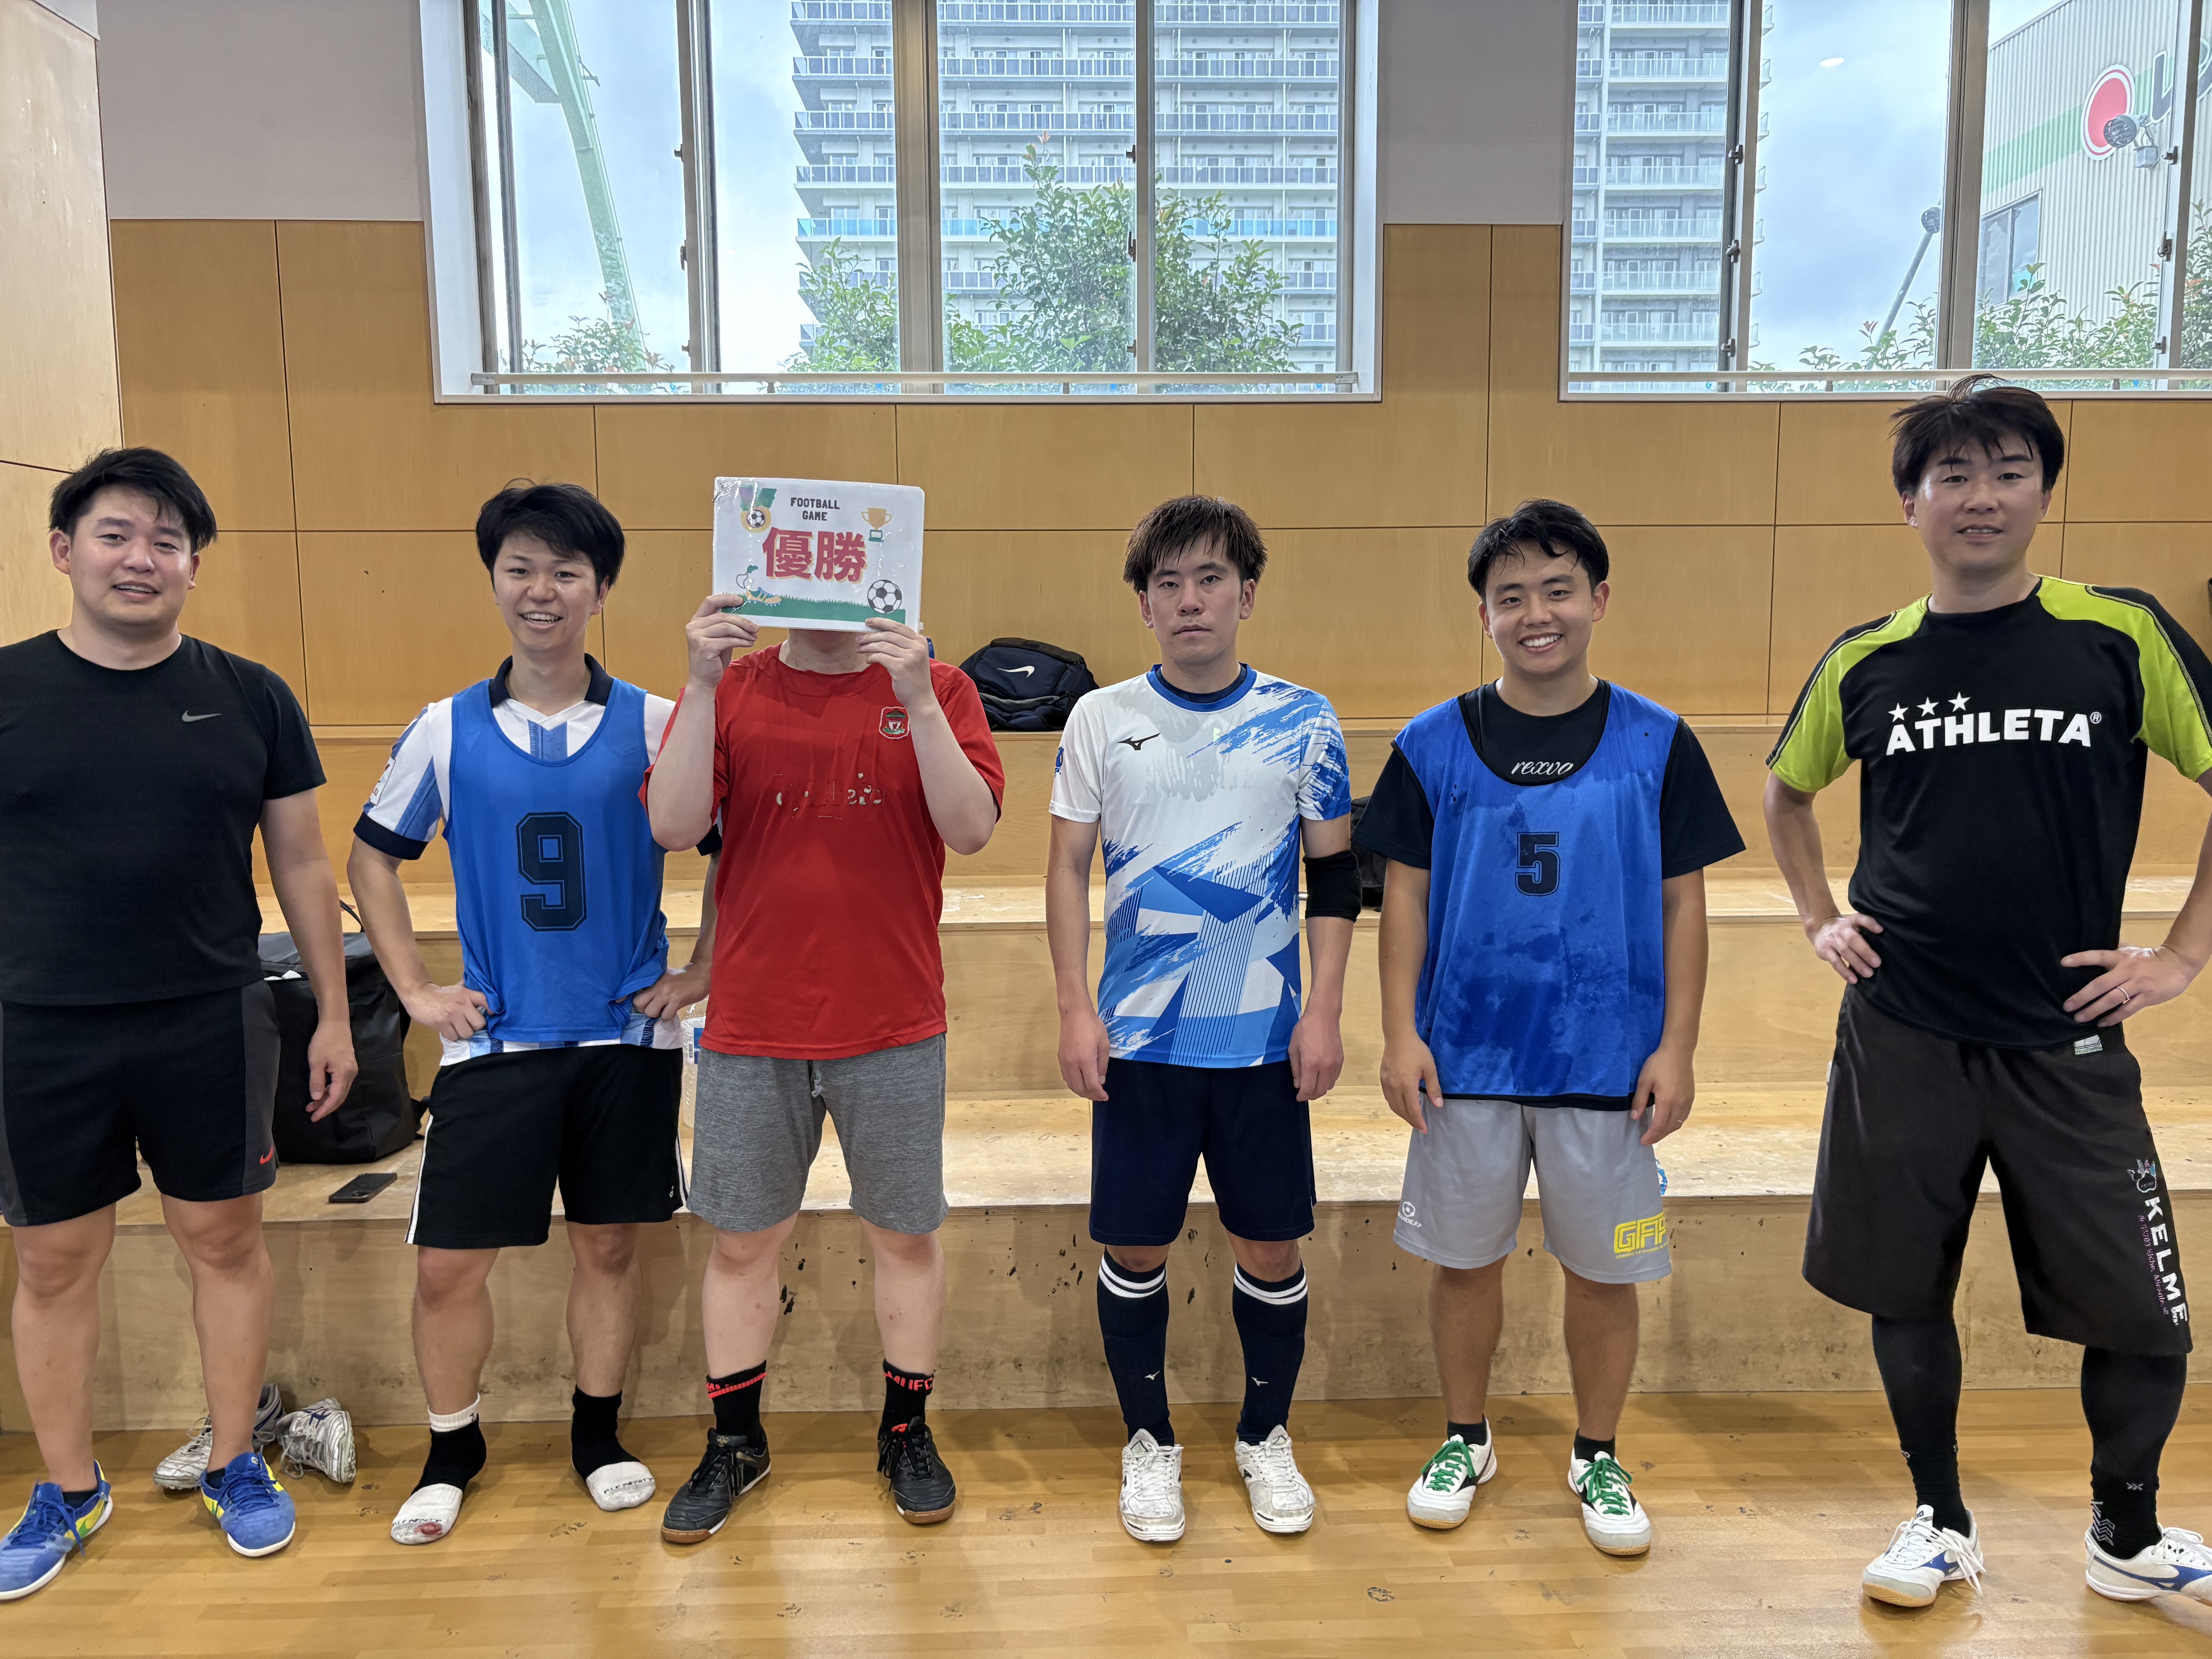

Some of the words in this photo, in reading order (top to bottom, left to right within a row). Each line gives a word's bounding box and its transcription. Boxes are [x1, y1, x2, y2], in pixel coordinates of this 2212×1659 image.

[790, 497, 840, 510] FOOTBALL
[802, 510, 828, 521] GAME
[762, 527, 867, 584] 優勝
[1511, 761, 1573, 775] rexvo
[515, 811, 587, 932] 9
[1515, 832, 1561, 896] 5
[2145, 1196, 2188, 1326] KELME
